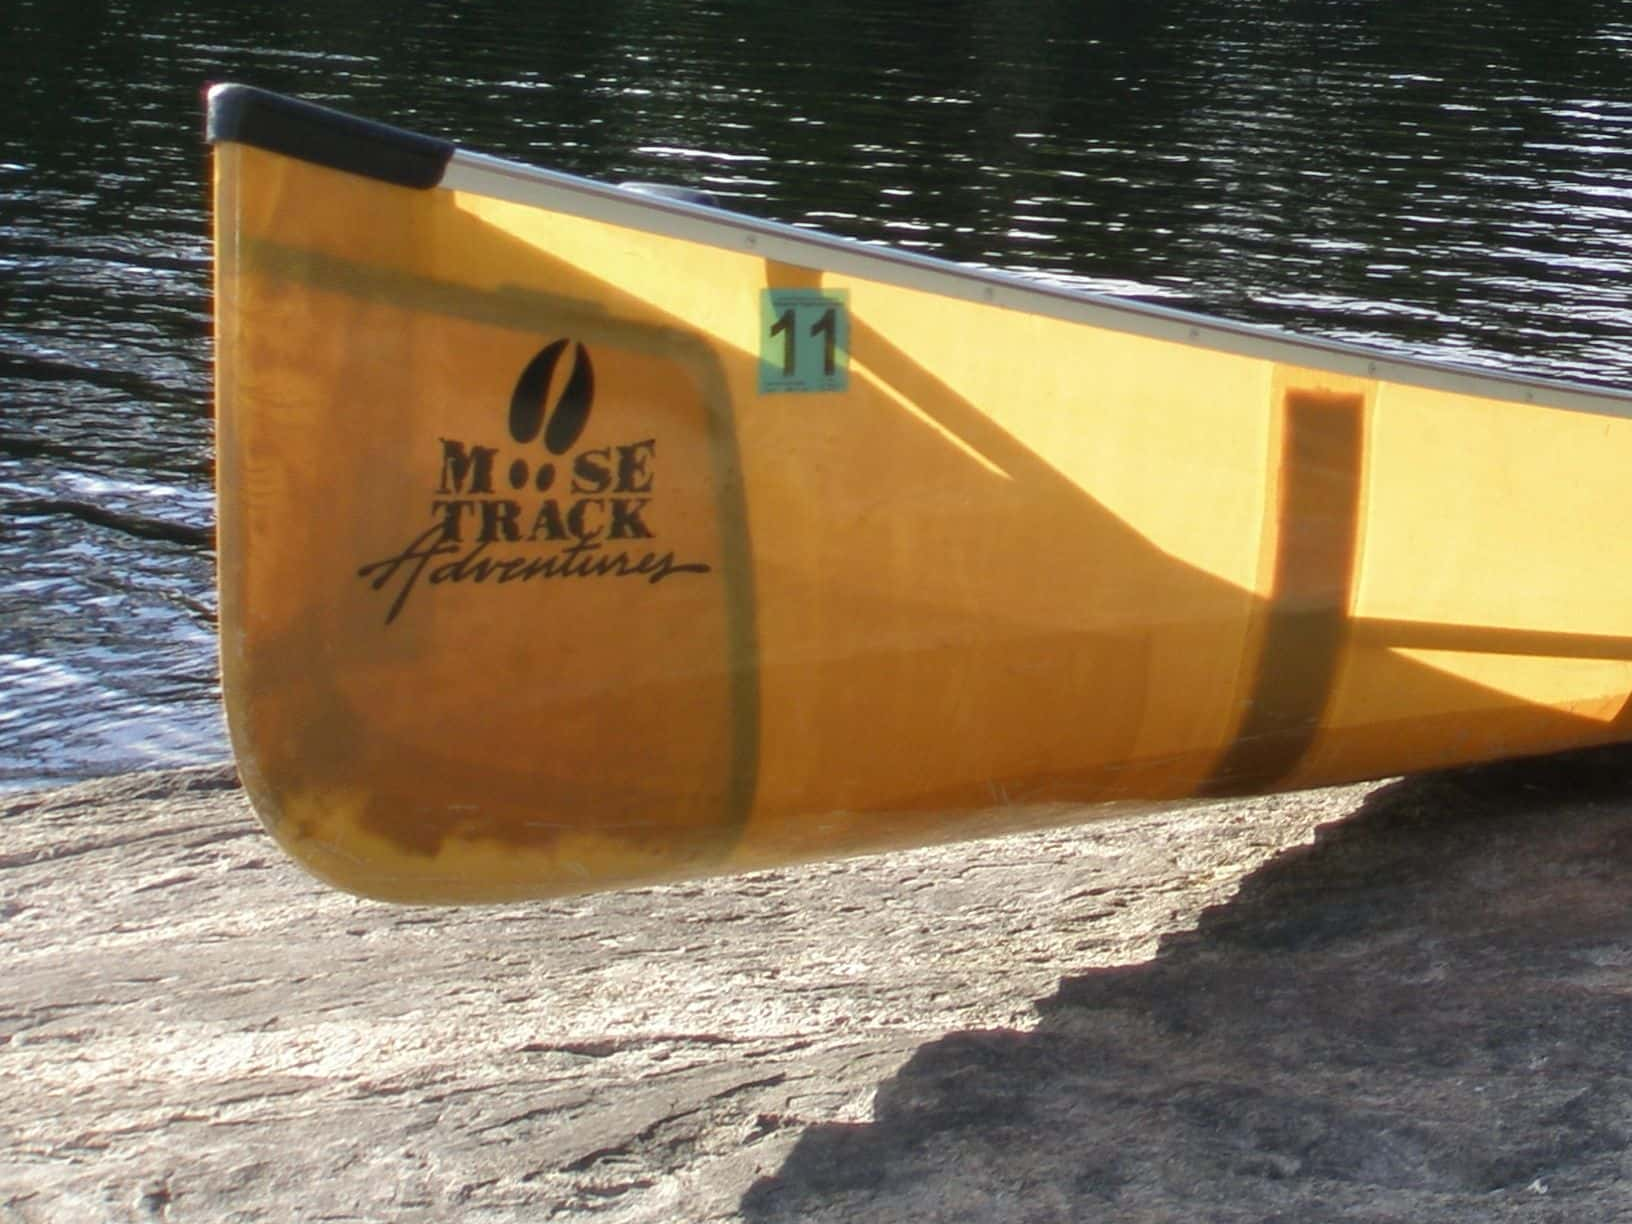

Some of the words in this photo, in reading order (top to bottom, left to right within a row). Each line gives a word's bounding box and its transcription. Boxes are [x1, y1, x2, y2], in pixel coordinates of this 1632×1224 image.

[769, 307, 837, 377] 11
[435, 437, 656, 495] MOOSE
[431, 497, 656, 543] TRACK
[357, 521, 711, 625] Adventures
